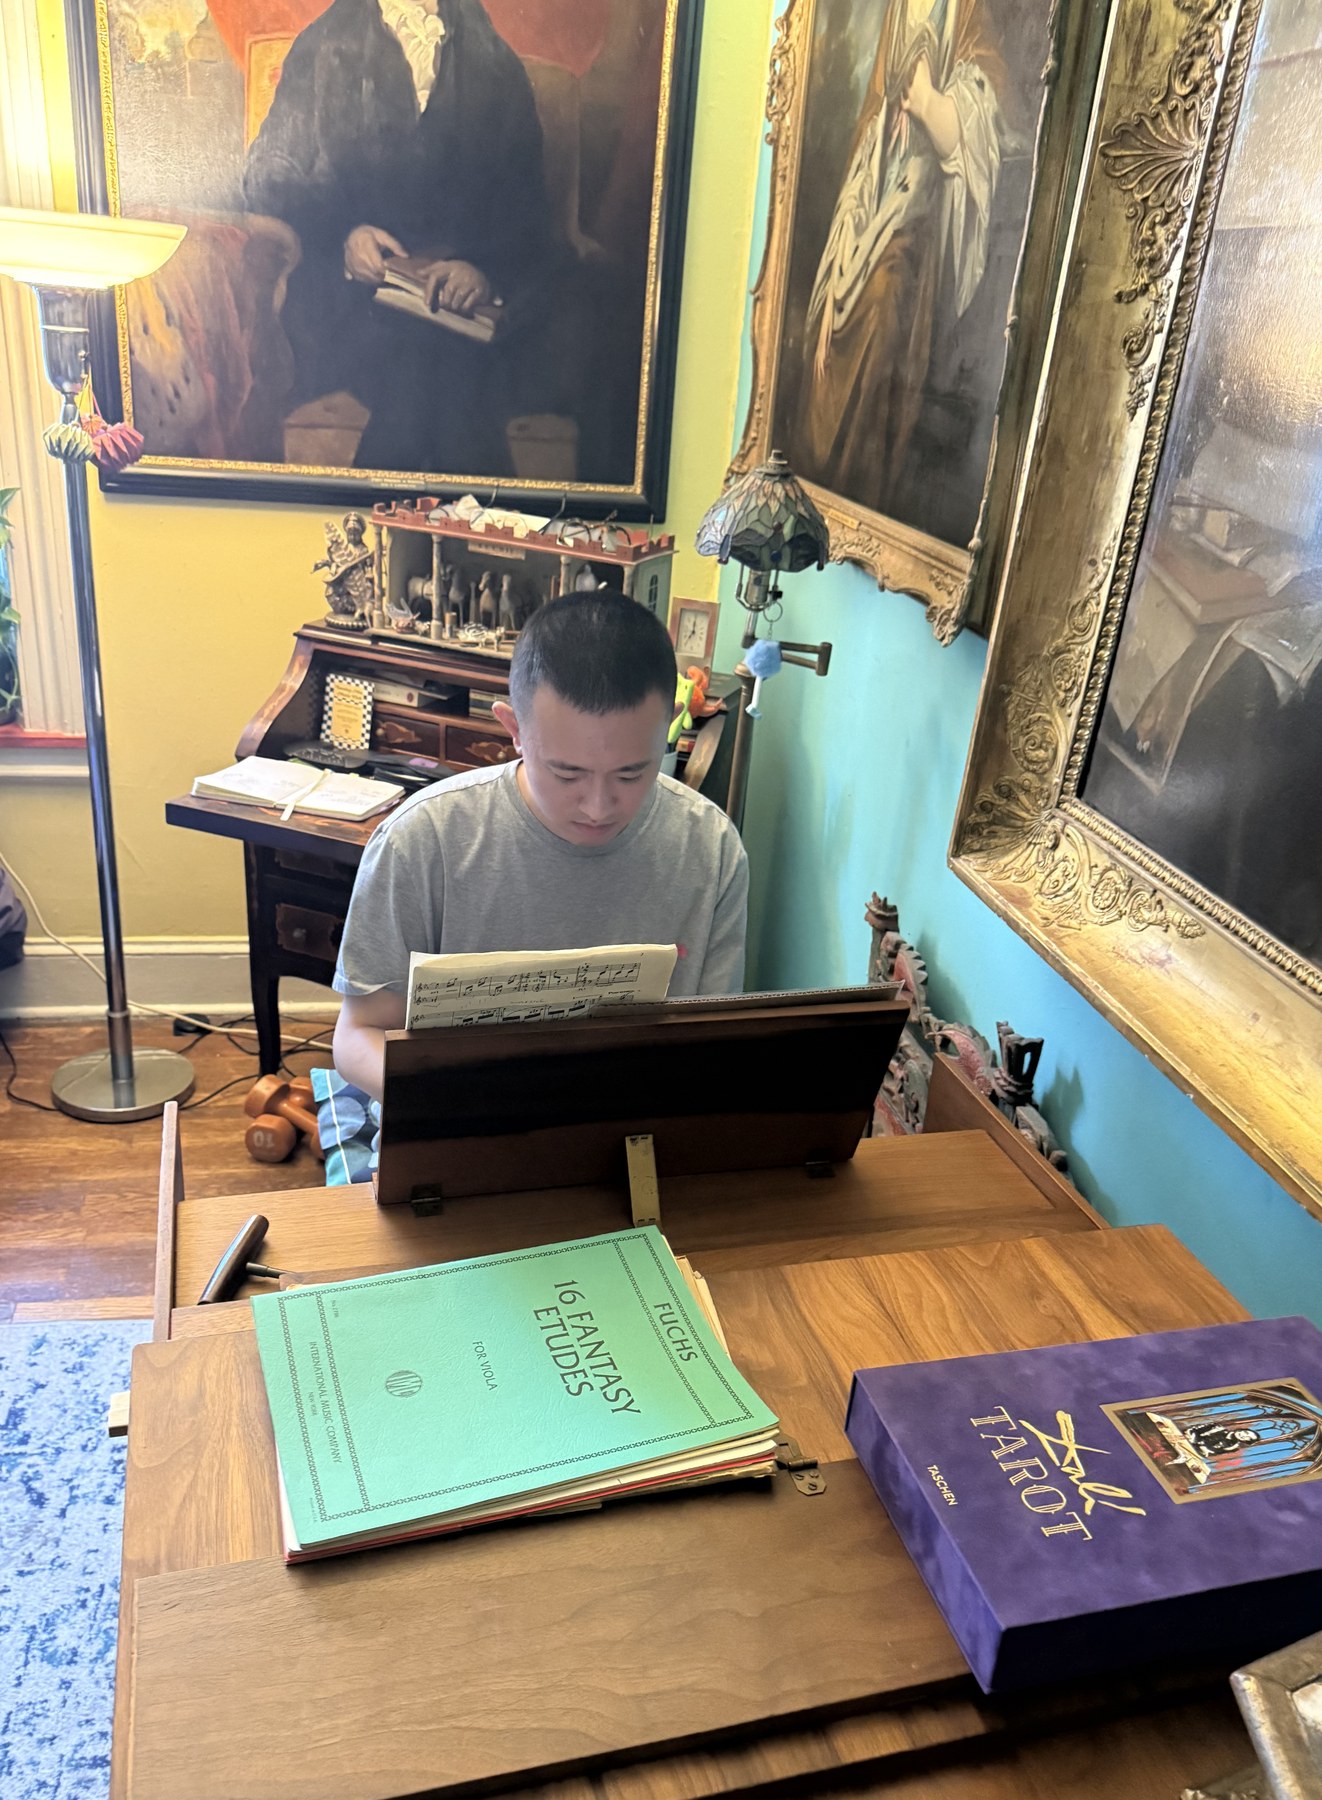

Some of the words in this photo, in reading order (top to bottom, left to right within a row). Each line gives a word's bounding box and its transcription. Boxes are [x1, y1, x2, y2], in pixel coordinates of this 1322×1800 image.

[554, 1279, 586, 1305] 16
[533, 1305, 594, 1397] ETUDES
[654, 1302, 698, 1362] FUCHS
[309, 1341, 327, 1398] INTERNATIONAL
[472, 1341, 487, 1360] FOR
[480, 1360, 498, 1390] VIOLA
[567, 1311, 641, 1414] FANTASY
[321, 1399, 333, 1424] MUSIC
[326, 1425, 342, 1463] COMPANY
[927, 1464, 958, 1507] TASCHEN
[970, 1405, 1093, 1541] TAROT
